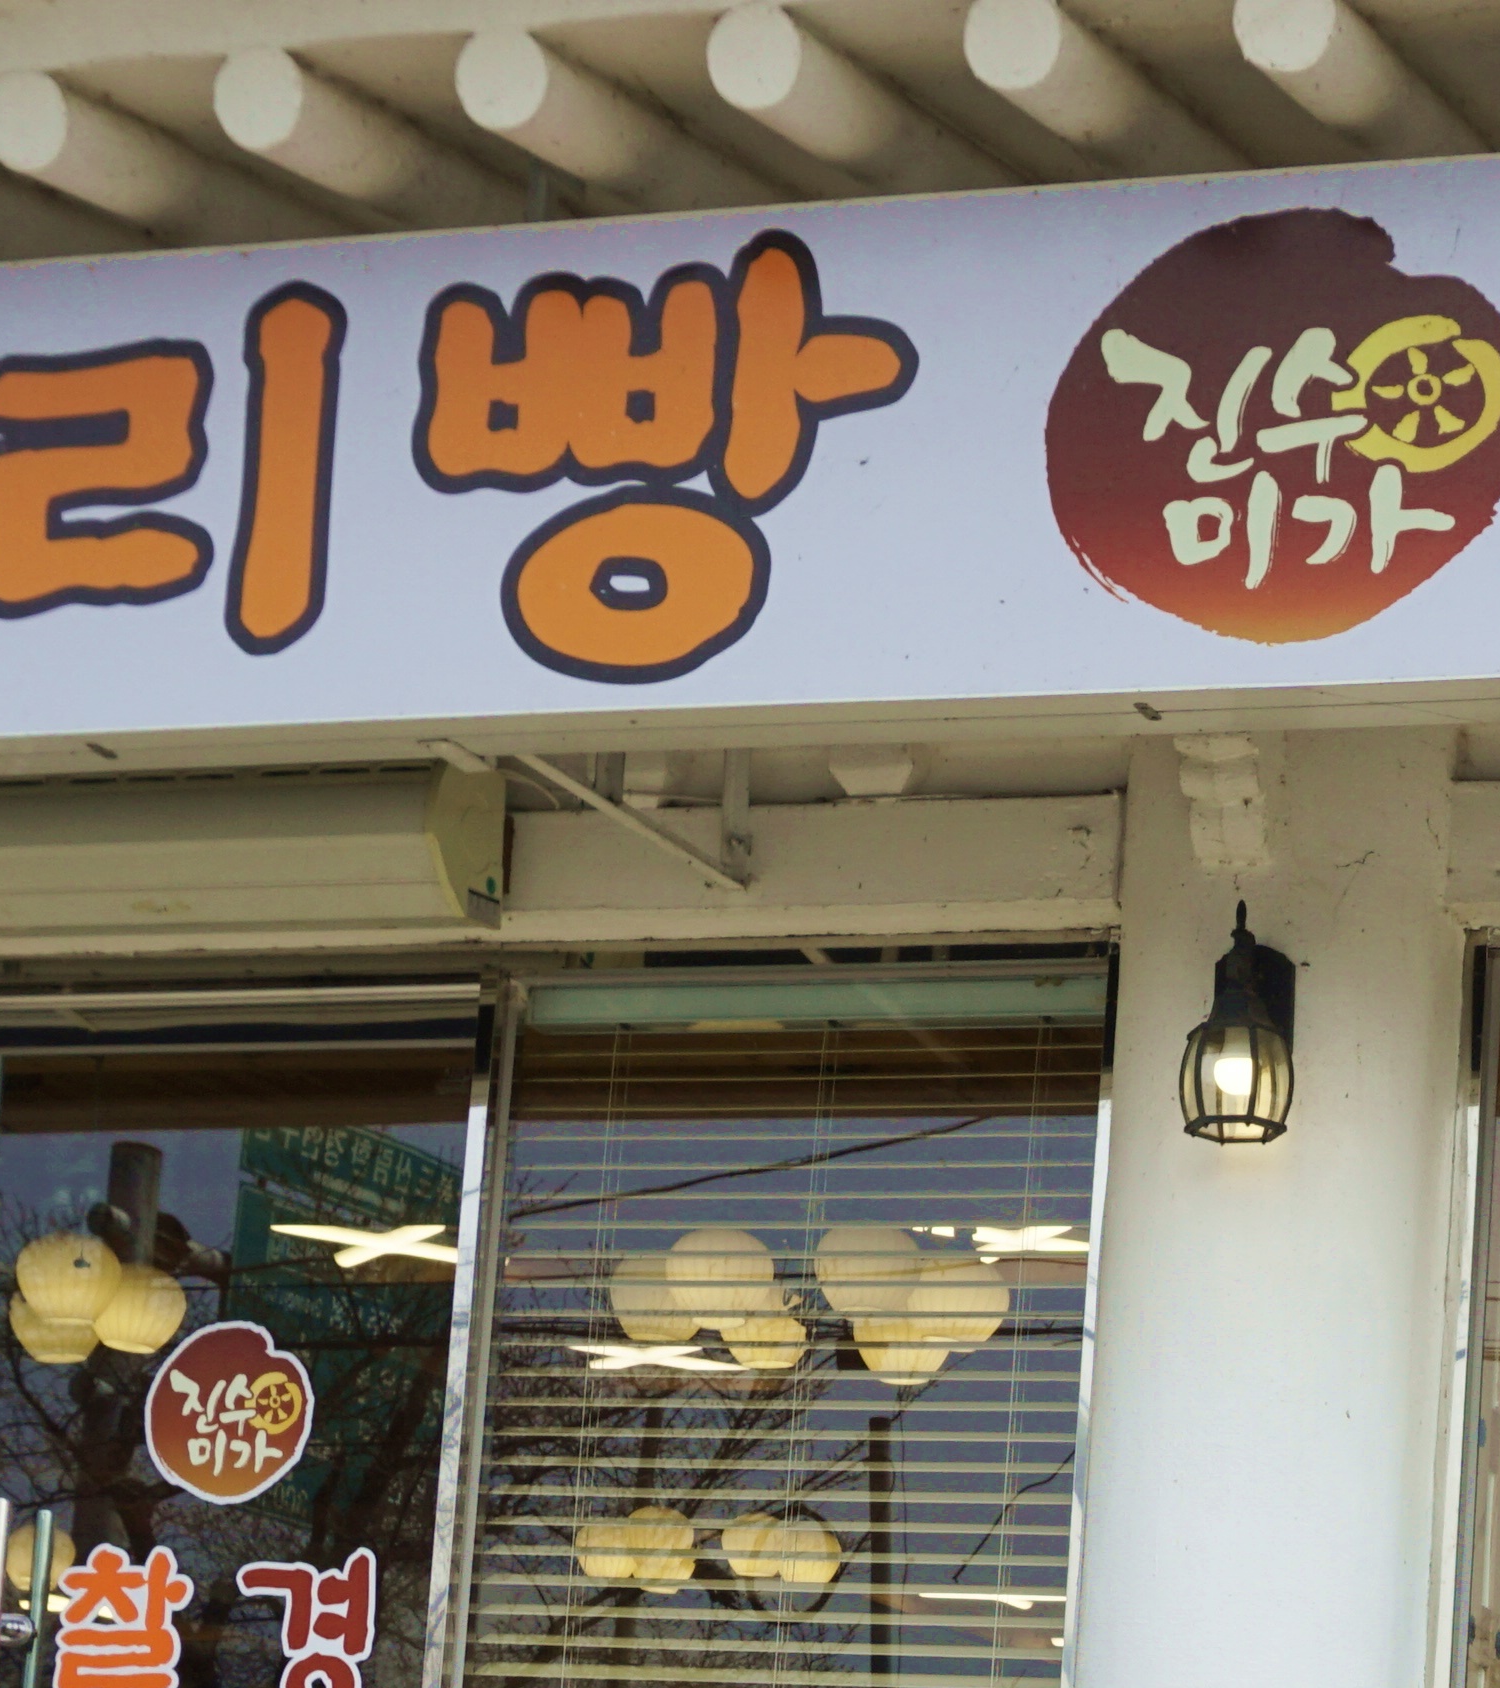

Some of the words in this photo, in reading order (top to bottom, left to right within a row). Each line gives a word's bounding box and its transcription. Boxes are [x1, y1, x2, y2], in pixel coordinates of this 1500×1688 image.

[1102, 328, 1368, 483] 진수
[1162, 465, 1456, 589] 미가
[169, 1368, 257, 1437] 진수
[187, 1429, 284, 1477] 미가
